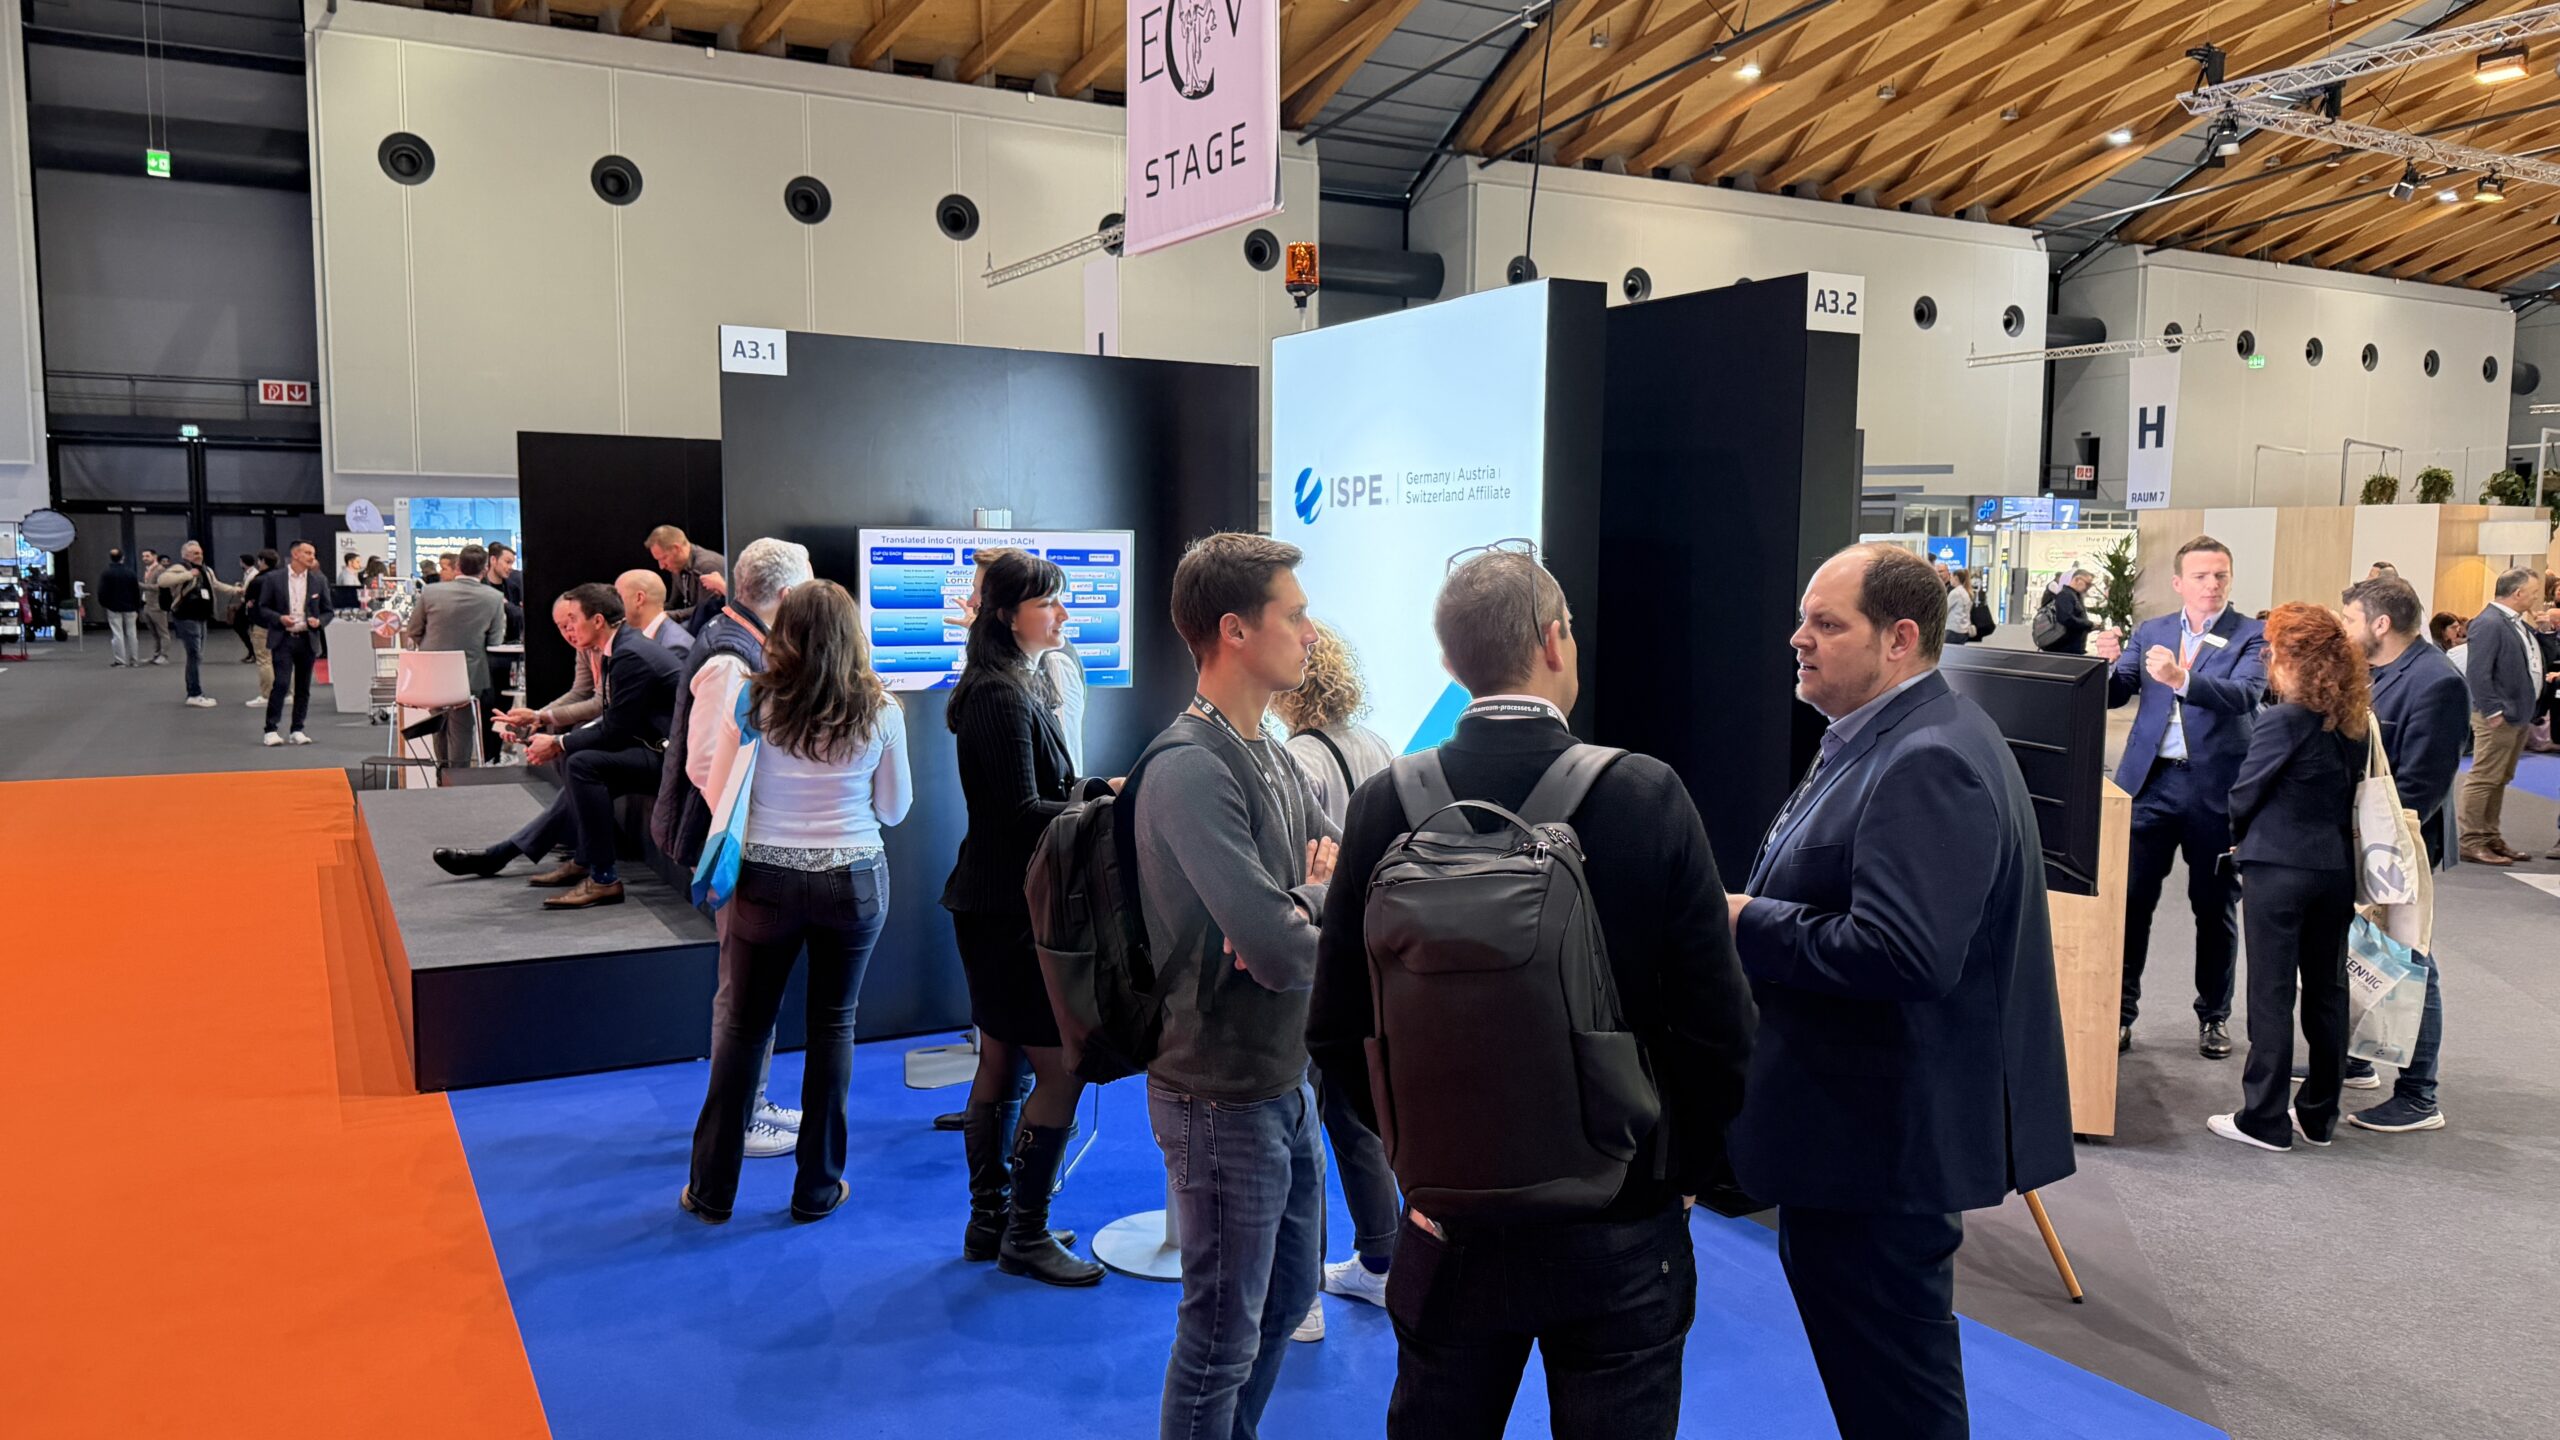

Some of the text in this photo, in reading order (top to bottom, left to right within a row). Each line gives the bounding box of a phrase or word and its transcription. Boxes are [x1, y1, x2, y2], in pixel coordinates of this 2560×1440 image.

[1146, 122, 1246, 198] STAGE
[1814, 289, 1857, 315] A3.2
[732, 340, 775, 360] A3.1
[2138, 405, 2166, 449] H
[1406, 465, 1496, 485] Germany Austria
[1406, 485, 1511, 504] Switzerland Affiliate
[2131, 491, 2165, 503] RAUM 7
[2061, 504, 2075, 530] 7
[881, 535, 1035, 545] Translated into Critical Utilities DACH
